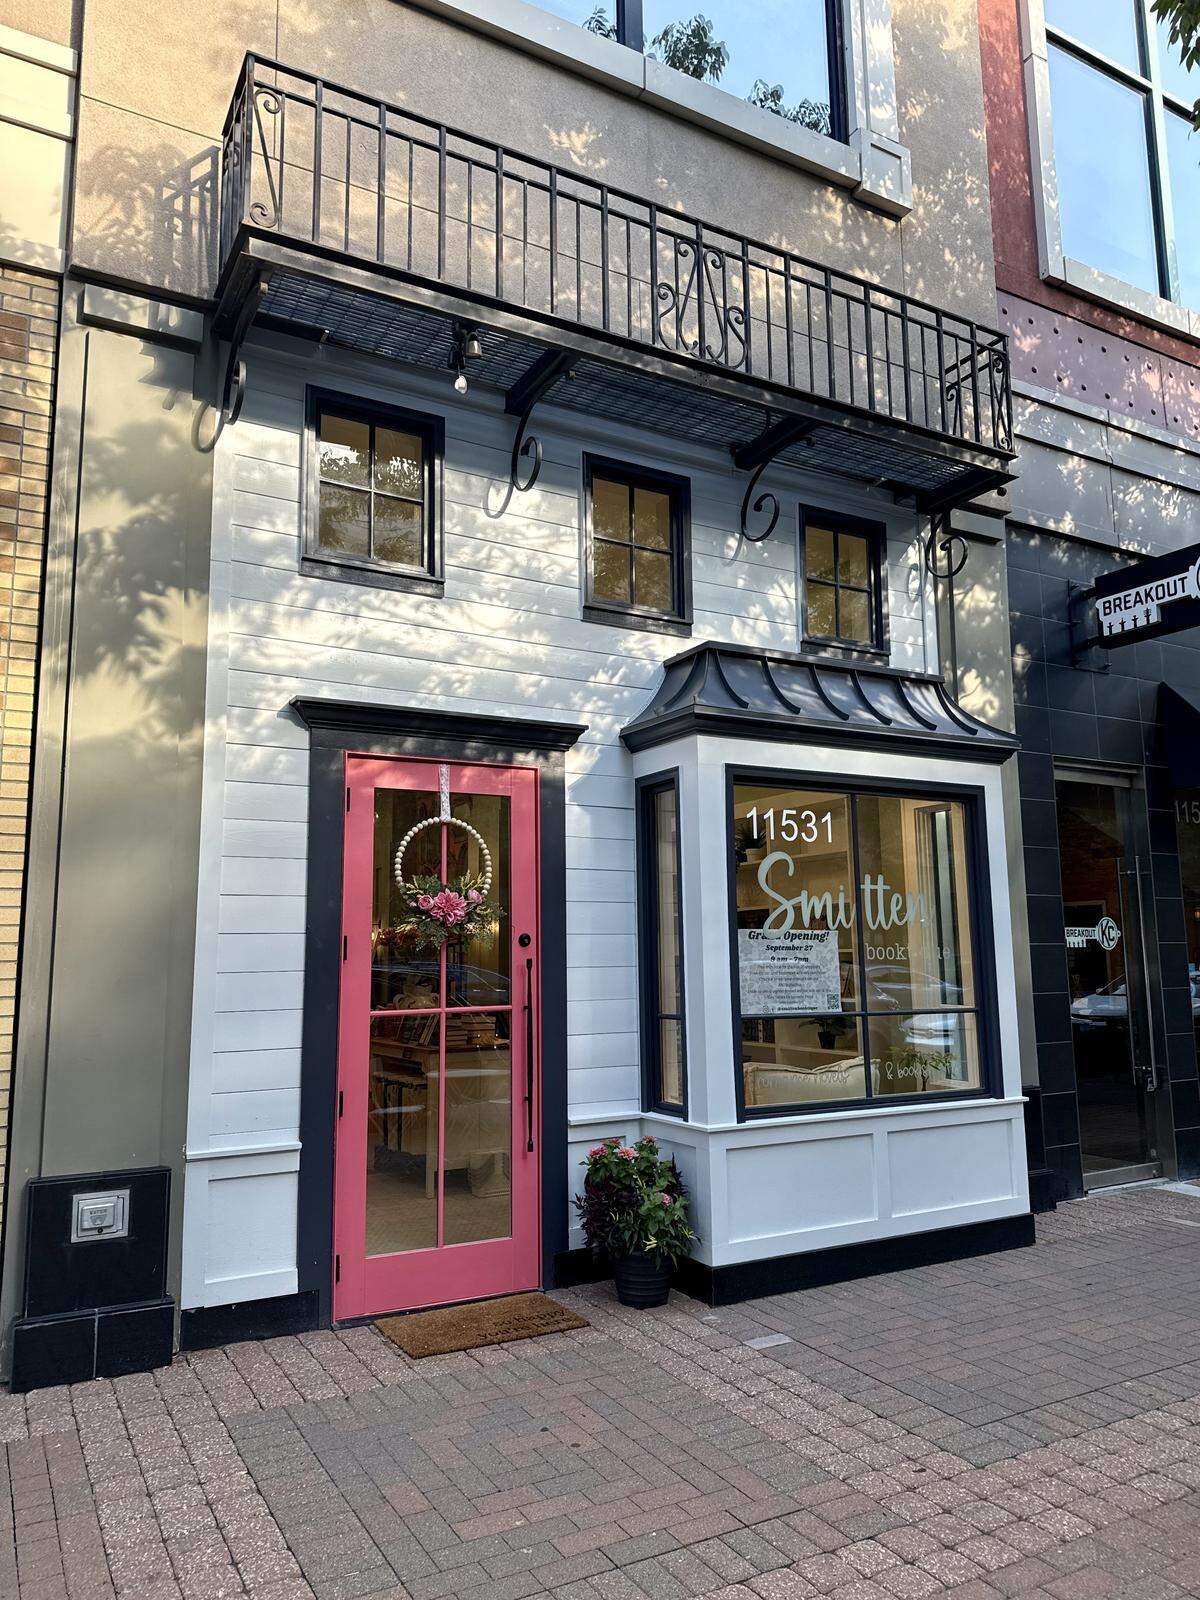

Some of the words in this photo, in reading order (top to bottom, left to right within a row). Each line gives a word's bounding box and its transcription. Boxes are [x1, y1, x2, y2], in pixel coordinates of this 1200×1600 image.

[1102, 576, 1188, 617] BREAKOUT
[746, 806, 834, 843] 11531
[757, 851, 930, 939] Smitten
[748, 930, 781, 941] Gra
[783, 931, 830, 943] Opening!
[1065, 928, 1097, 938] BREAKOUT
[1100, 920, 1115, 947] KC
[765, 944, 803, 953] September
[804, 944, 814, 952] 27
[885, 1061, 894, 1081] &
